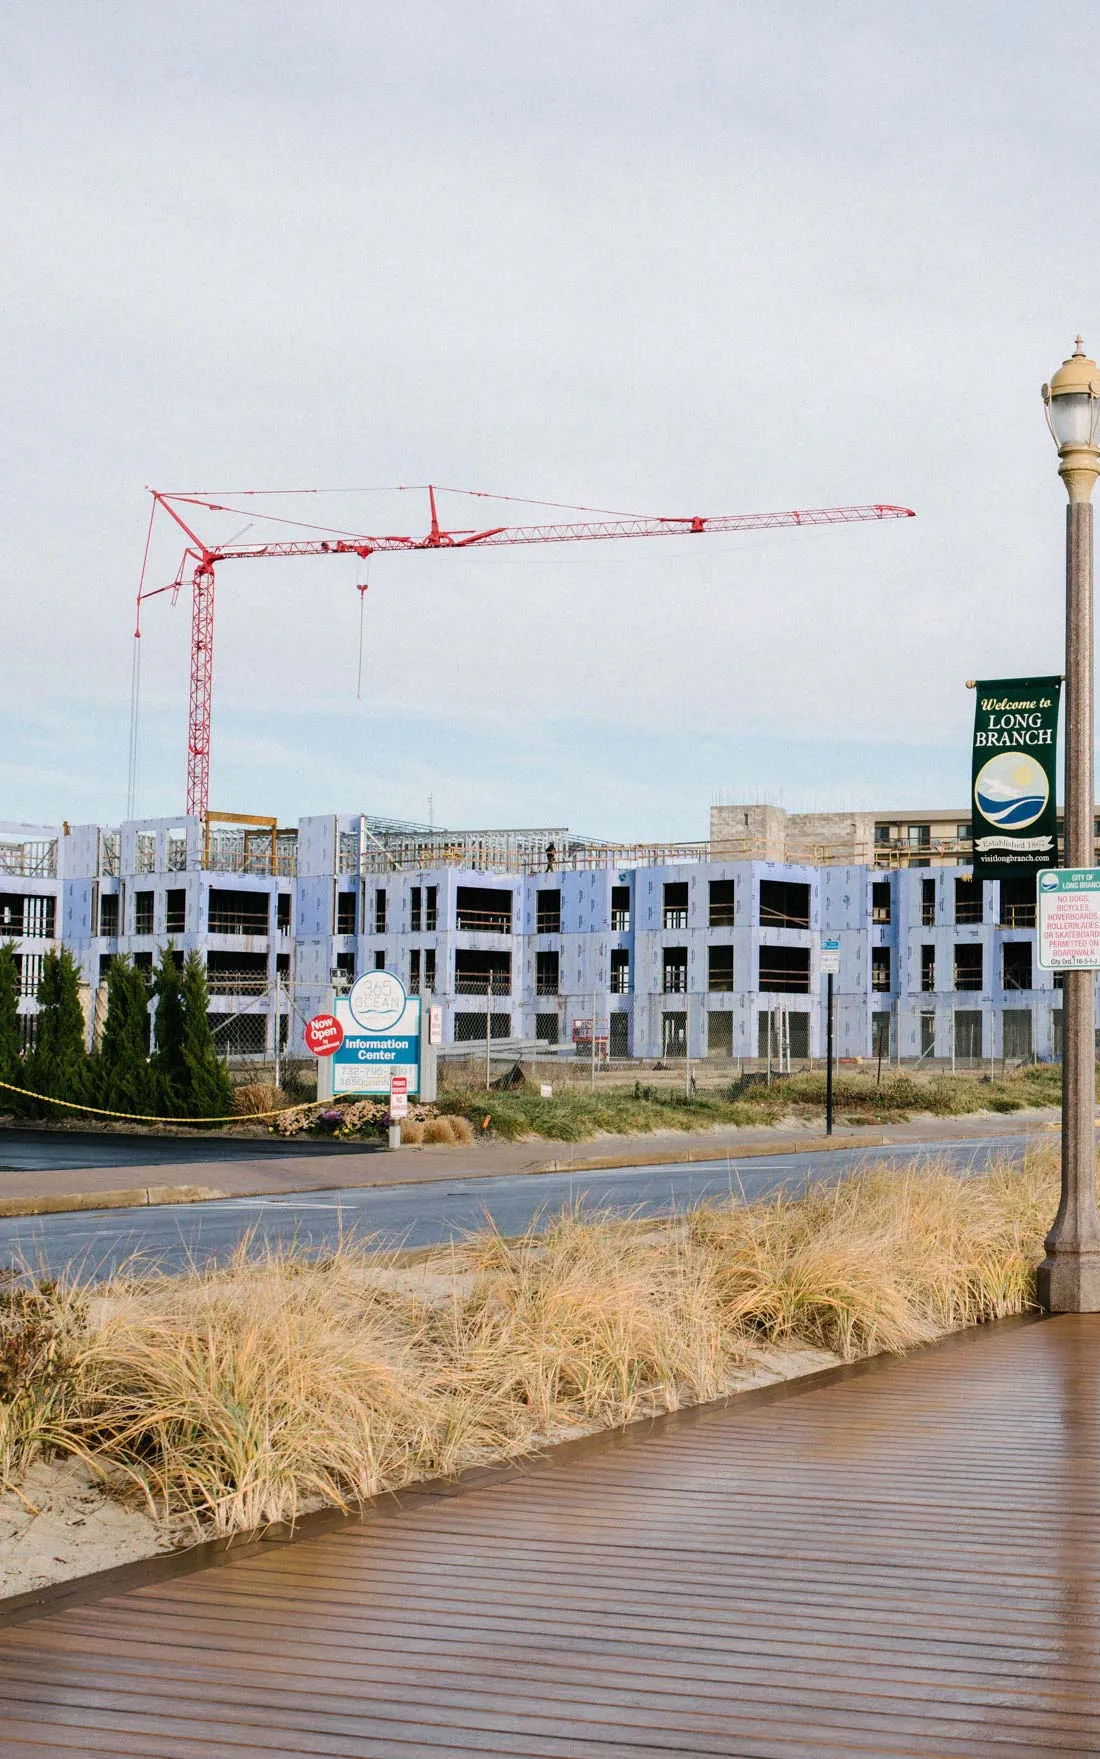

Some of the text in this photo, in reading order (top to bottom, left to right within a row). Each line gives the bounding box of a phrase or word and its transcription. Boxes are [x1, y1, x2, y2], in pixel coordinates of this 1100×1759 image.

[981, 697, 1052, 711] Welcome to
[988, 712, 1042, 729] LONG
[975, 729, 1053, 747] BRANCH
[983, 840, 1025, 849] Established
[980, 854, 1050, 863] visitlongbranch.com
[1057, 895, 1067, 903] NO
[1049, 939, 1099, 948] PERMITTED ON
[364, 980, 392, 996] 365
[355, 997, 399, 1007] OCEAN
[311, 1018, 333, 1030] Now
[311, 1027, 337, 1040] Open
[346, 1039, 408, 1049] Information
[358, 1050, 396, 1060] Center
